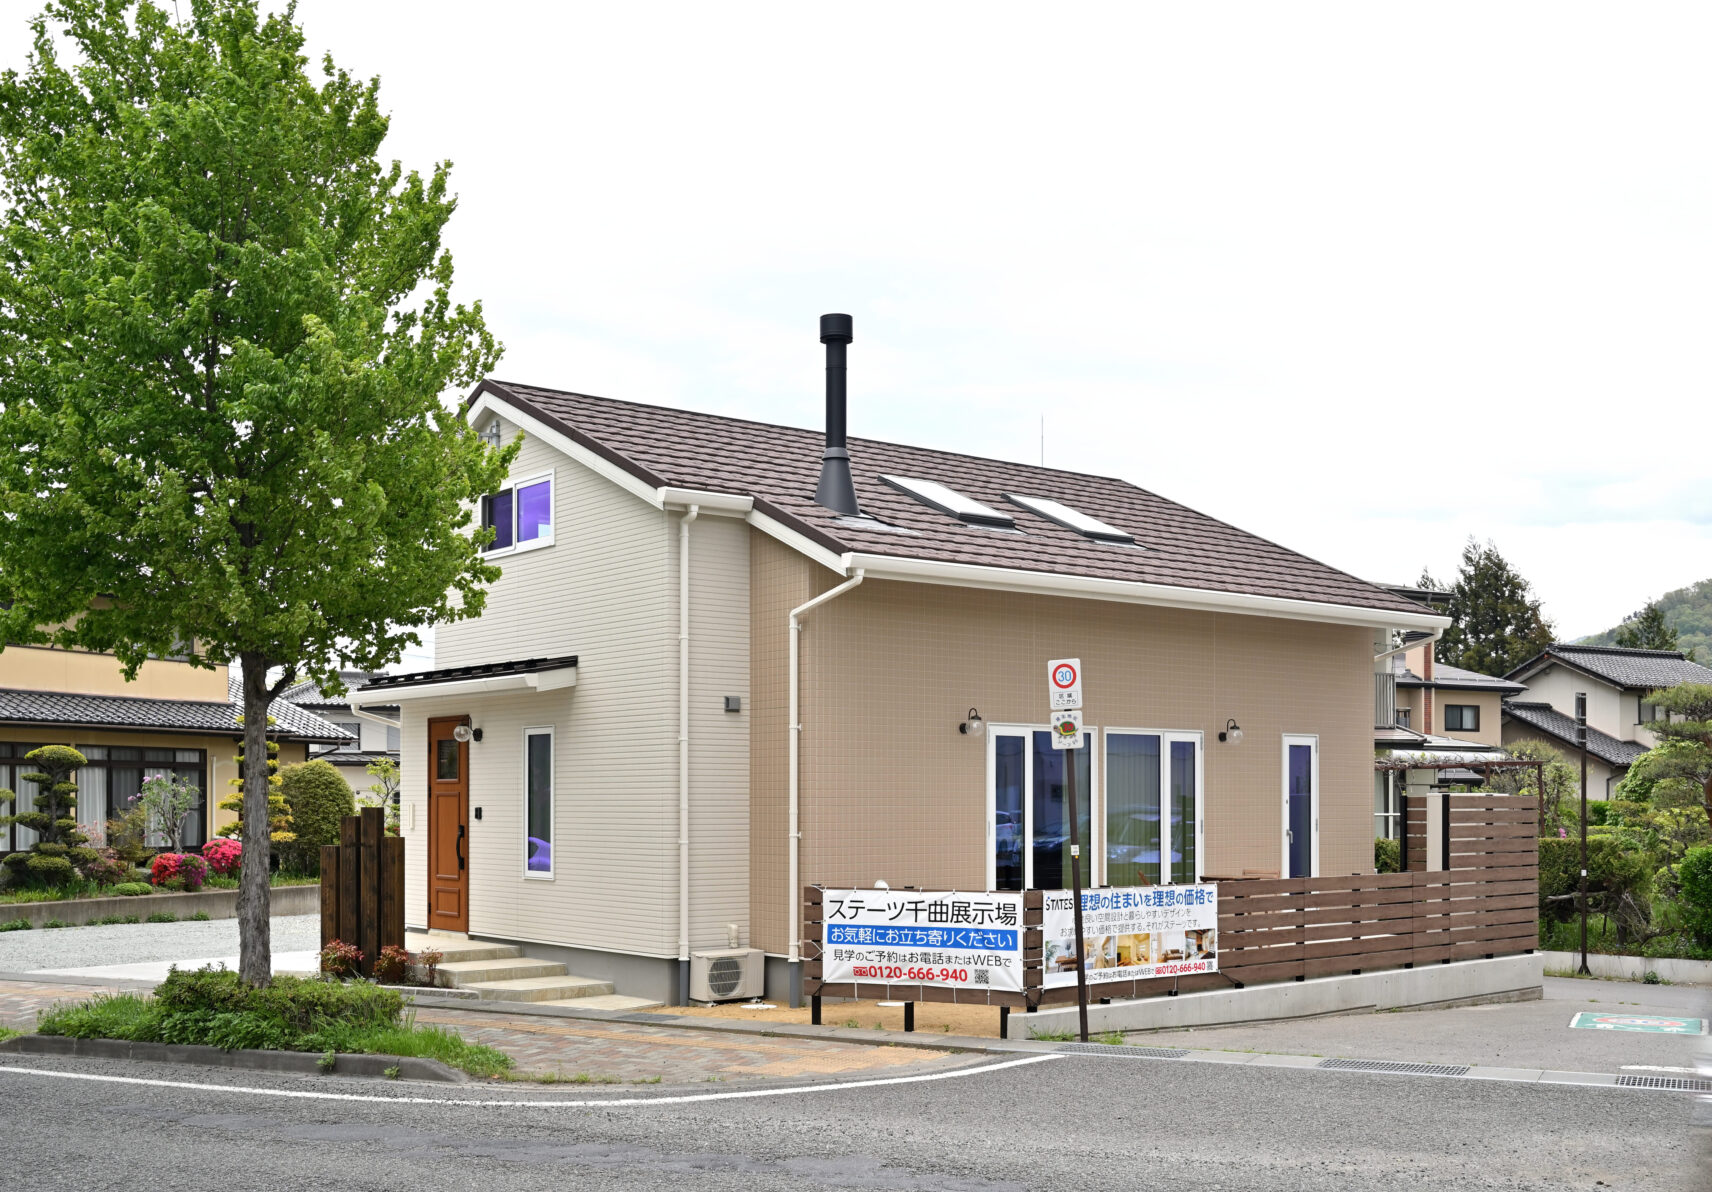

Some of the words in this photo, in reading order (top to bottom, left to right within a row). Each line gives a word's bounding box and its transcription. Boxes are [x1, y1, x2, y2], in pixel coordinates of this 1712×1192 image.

[1057, 670, 1072, 682] 30
[1062, 722, 1075, 732] 30
[1045, 897, 1074, 911] STATES
[828, 899, 1018, 926] ステーツ千曲展示場
[830, 926, 1013, 948] お気軽にお立ち寄りください
[833, 948, 1012, 967] 見学のご予約はお電話またはWEBで
[868, 965, 968, 982] 0120-666-940
[1162, 961, 1206, 975] 0120-666-940
